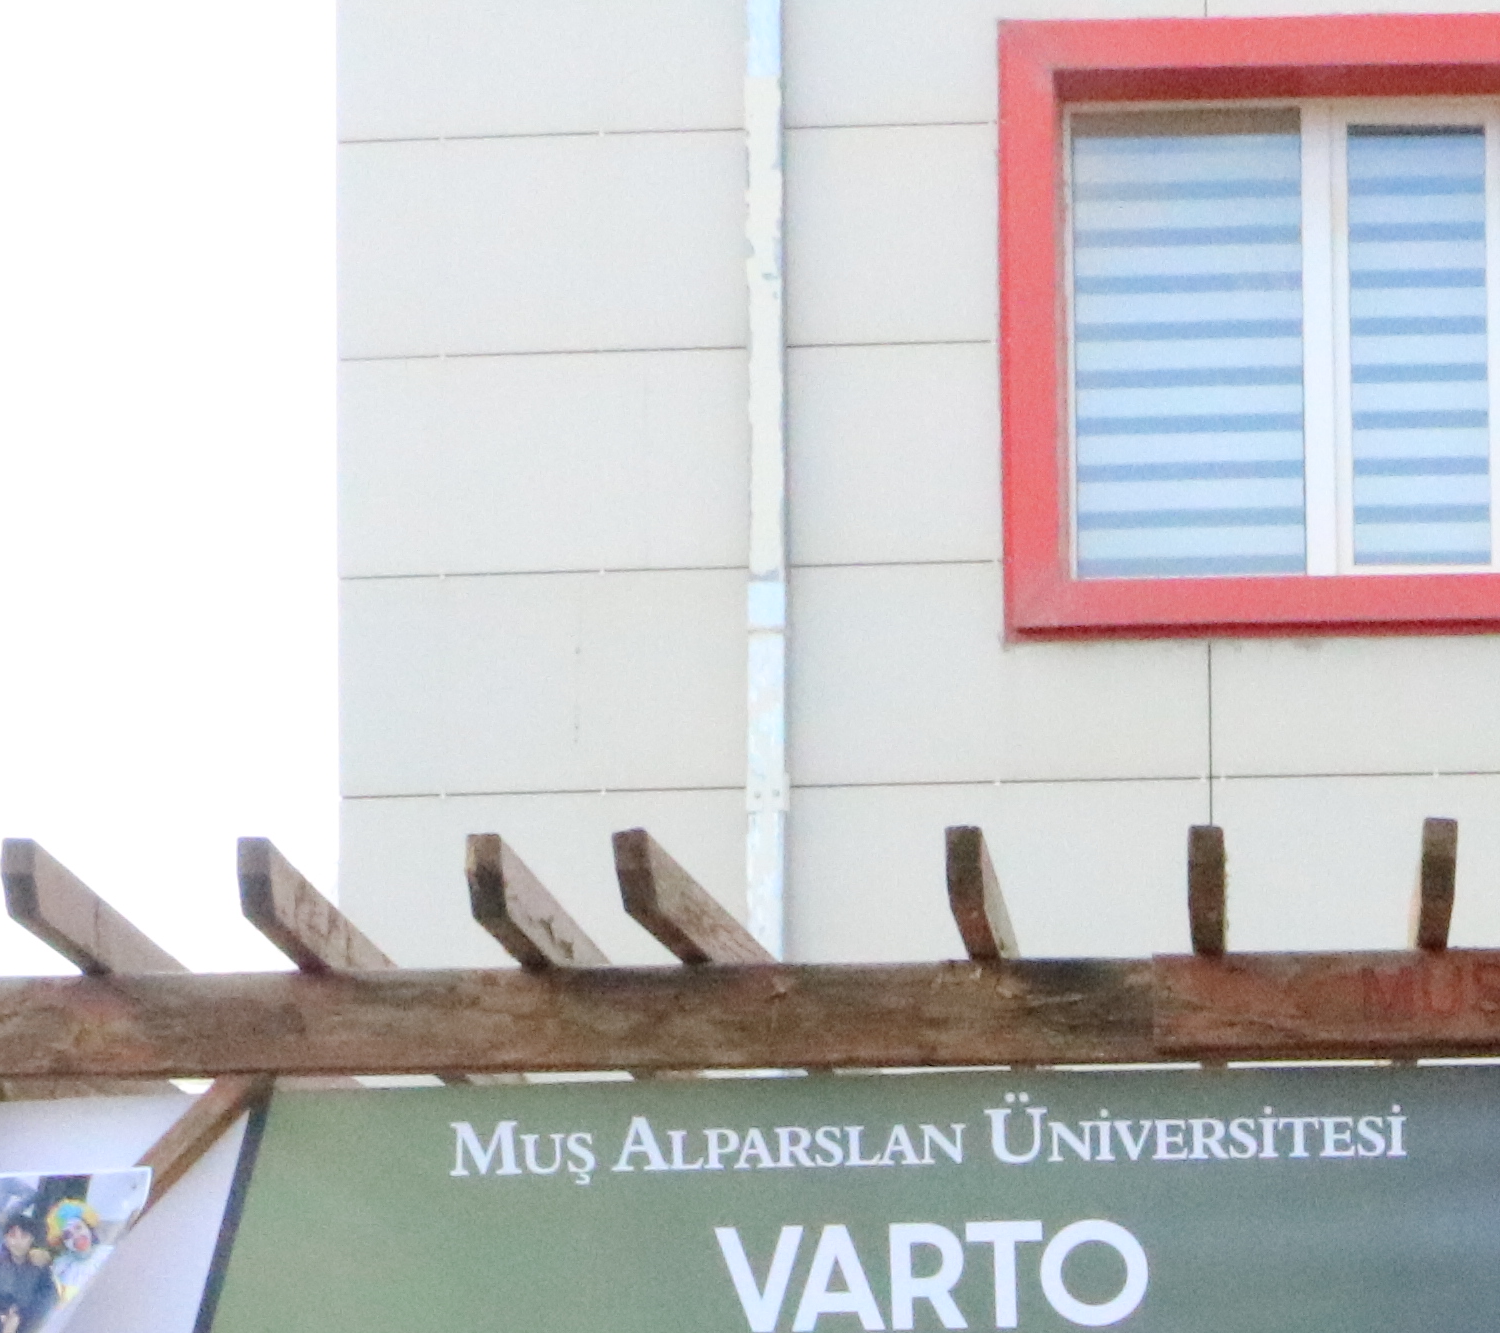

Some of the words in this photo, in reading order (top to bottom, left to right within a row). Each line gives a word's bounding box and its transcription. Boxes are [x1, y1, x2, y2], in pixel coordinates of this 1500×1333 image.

[449, 1120, 596, 1185] MUŞ
[612, 1116, 965, 1172] ALPARSLAN
[984, 1091, 1409, 1166] ÜNİVERSİTESİ
[713, 1217, 1149, 1333] VARTO
